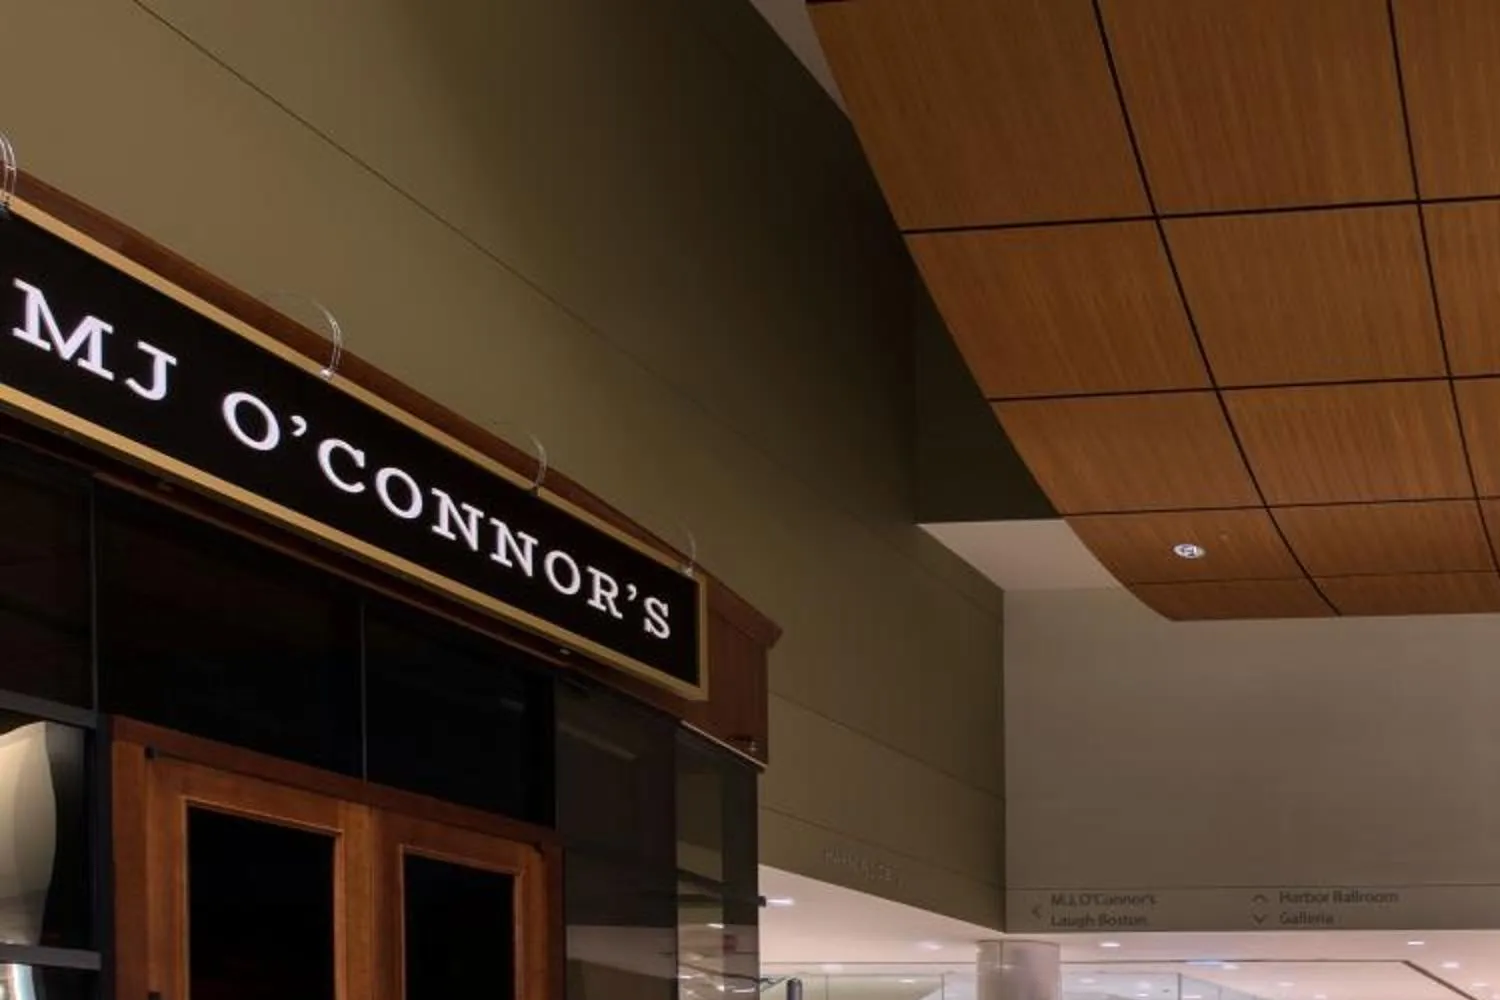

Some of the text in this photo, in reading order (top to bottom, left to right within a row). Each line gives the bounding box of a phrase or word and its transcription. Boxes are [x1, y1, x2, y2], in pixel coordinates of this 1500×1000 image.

[12, 278, 672, 640] MJ O'CONNOR'S
[1279, 889, 1398, 904] Harbor Ballroom
[1097, 913, 1148, 927] Boston
[1279, 911, 1334, 925] Galleria
